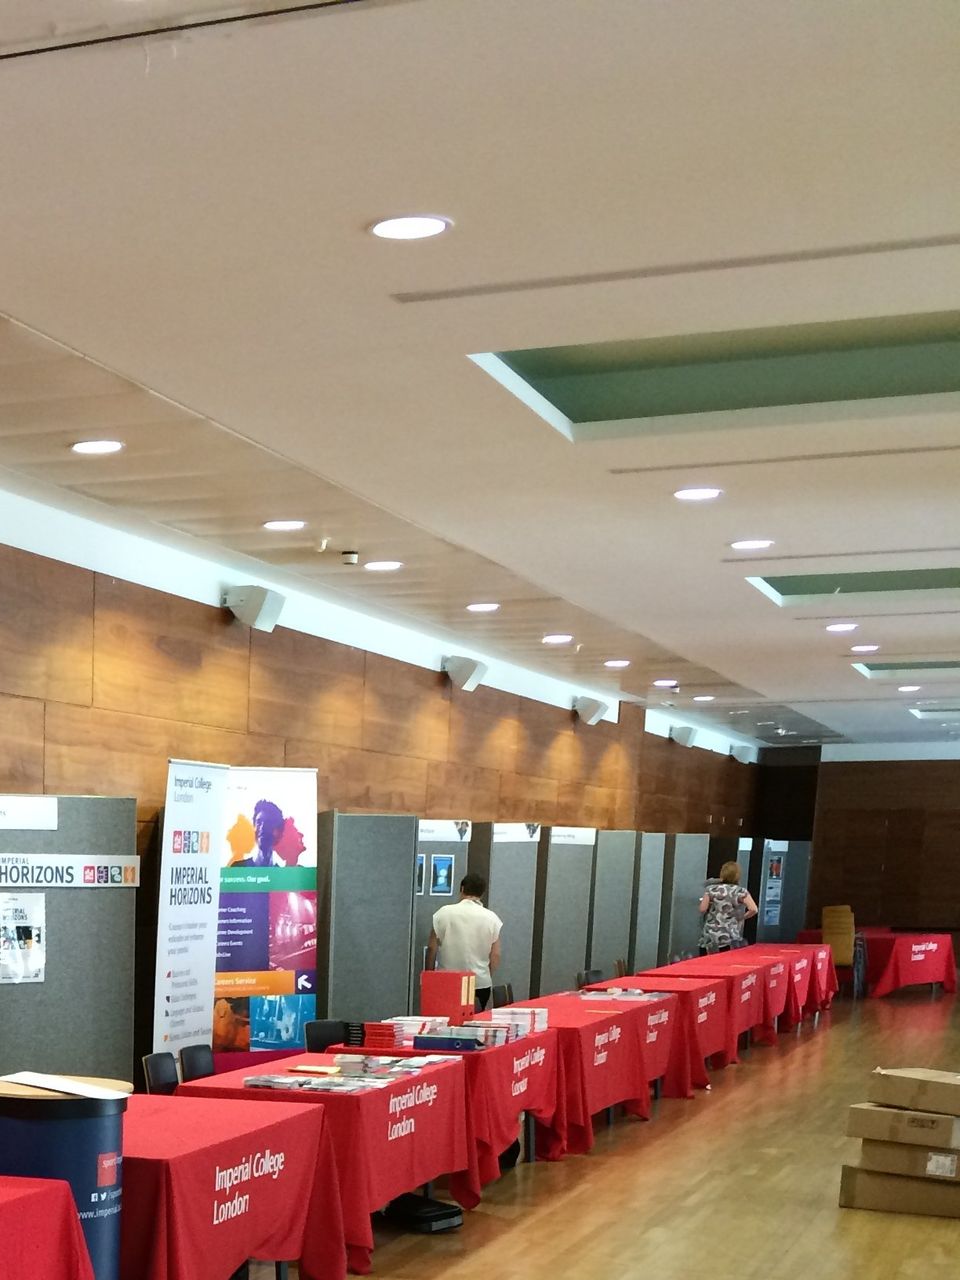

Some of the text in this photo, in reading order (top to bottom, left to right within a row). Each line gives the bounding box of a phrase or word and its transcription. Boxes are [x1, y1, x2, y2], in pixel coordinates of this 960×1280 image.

[170, 867, 209, 885] IMPERIAL
[169, 887, 212, 906] HORIZONS
[389, 1082, 438, 1118] Imperial College
[388, 1115, 415, 1141] London
[214, 1149, 285, 1194] Imperial College
[213, 1191, 250, 1225] London
